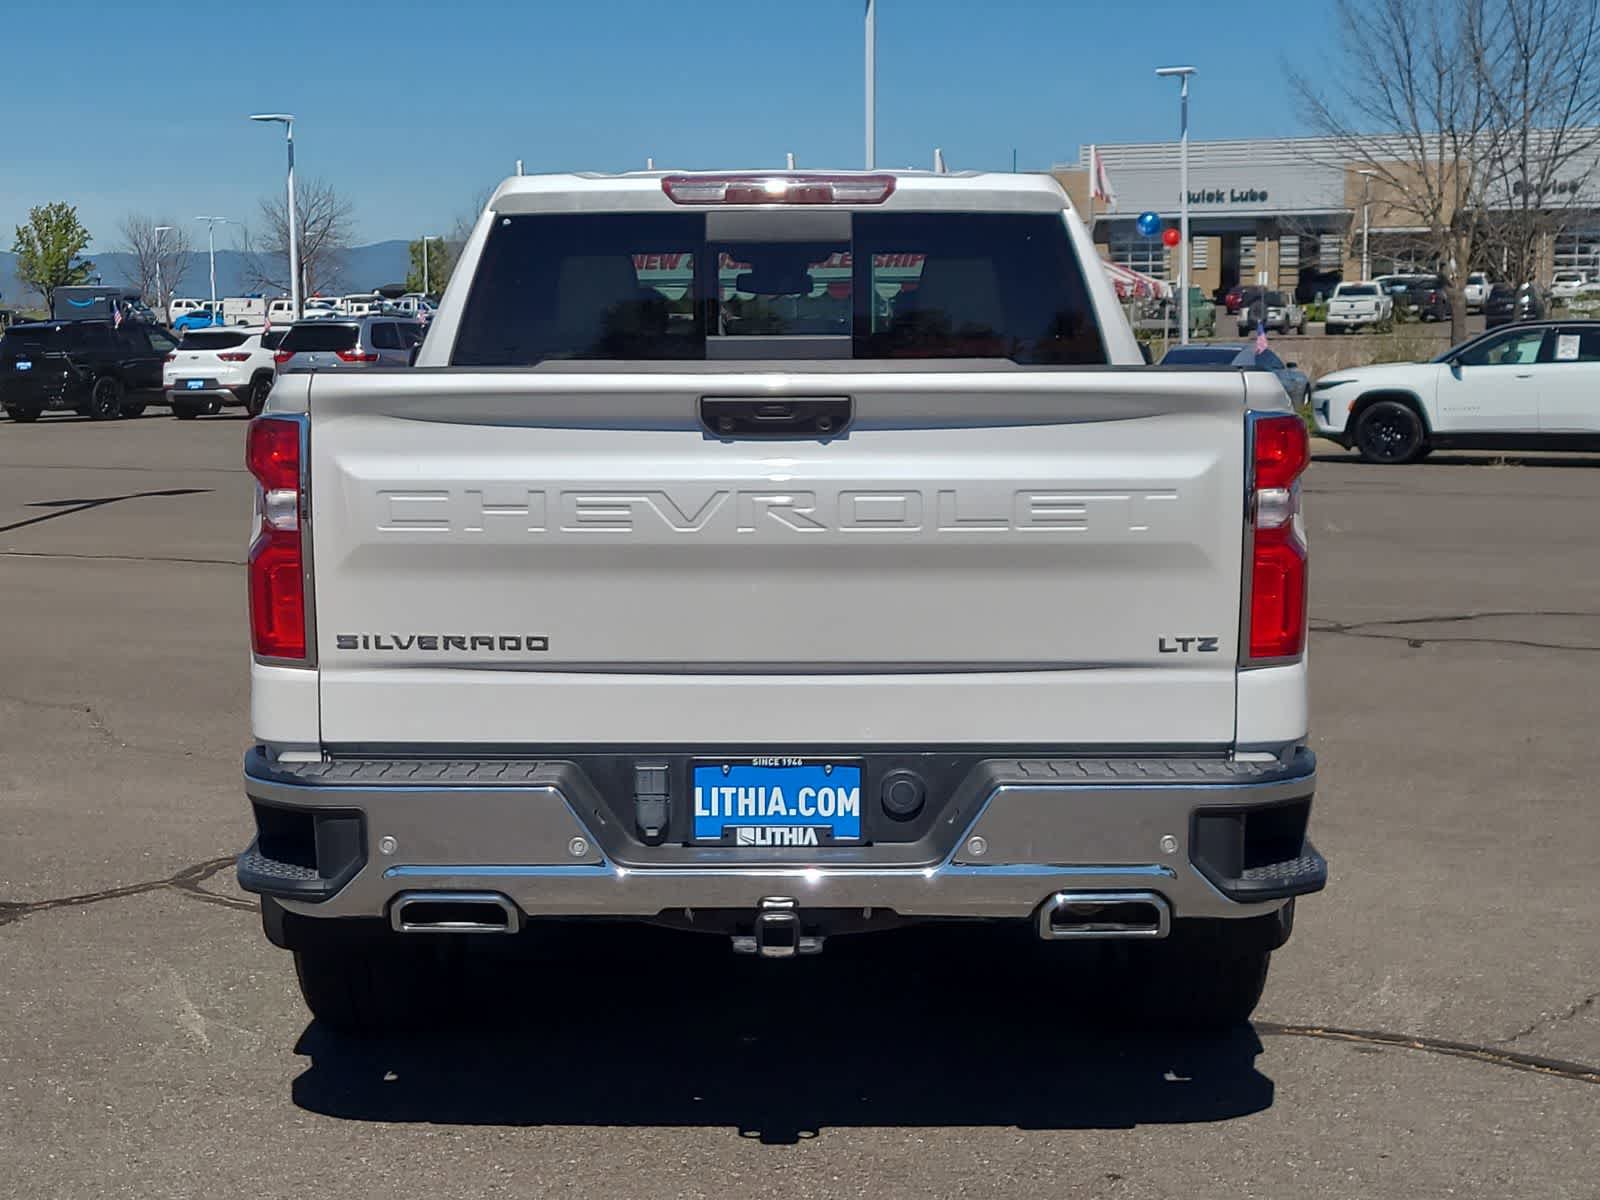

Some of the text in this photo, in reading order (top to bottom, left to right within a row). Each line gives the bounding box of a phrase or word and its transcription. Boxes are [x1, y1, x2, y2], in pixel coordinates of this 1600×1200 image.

[1230, 188, 1268, 203] Lube
[633, 253, 684, 270] NEW
[375, 490, 1179, 533] CHEVROLET
[336, 634, 549, 651] SILVERADO
[1159, 636, 1218, 653] LTZ
[752, 757, 803, 766] SINCE 1946
[694, 787, 860, 817] LITHIA.COM
[755, 827, 818, 846] LITHIA
